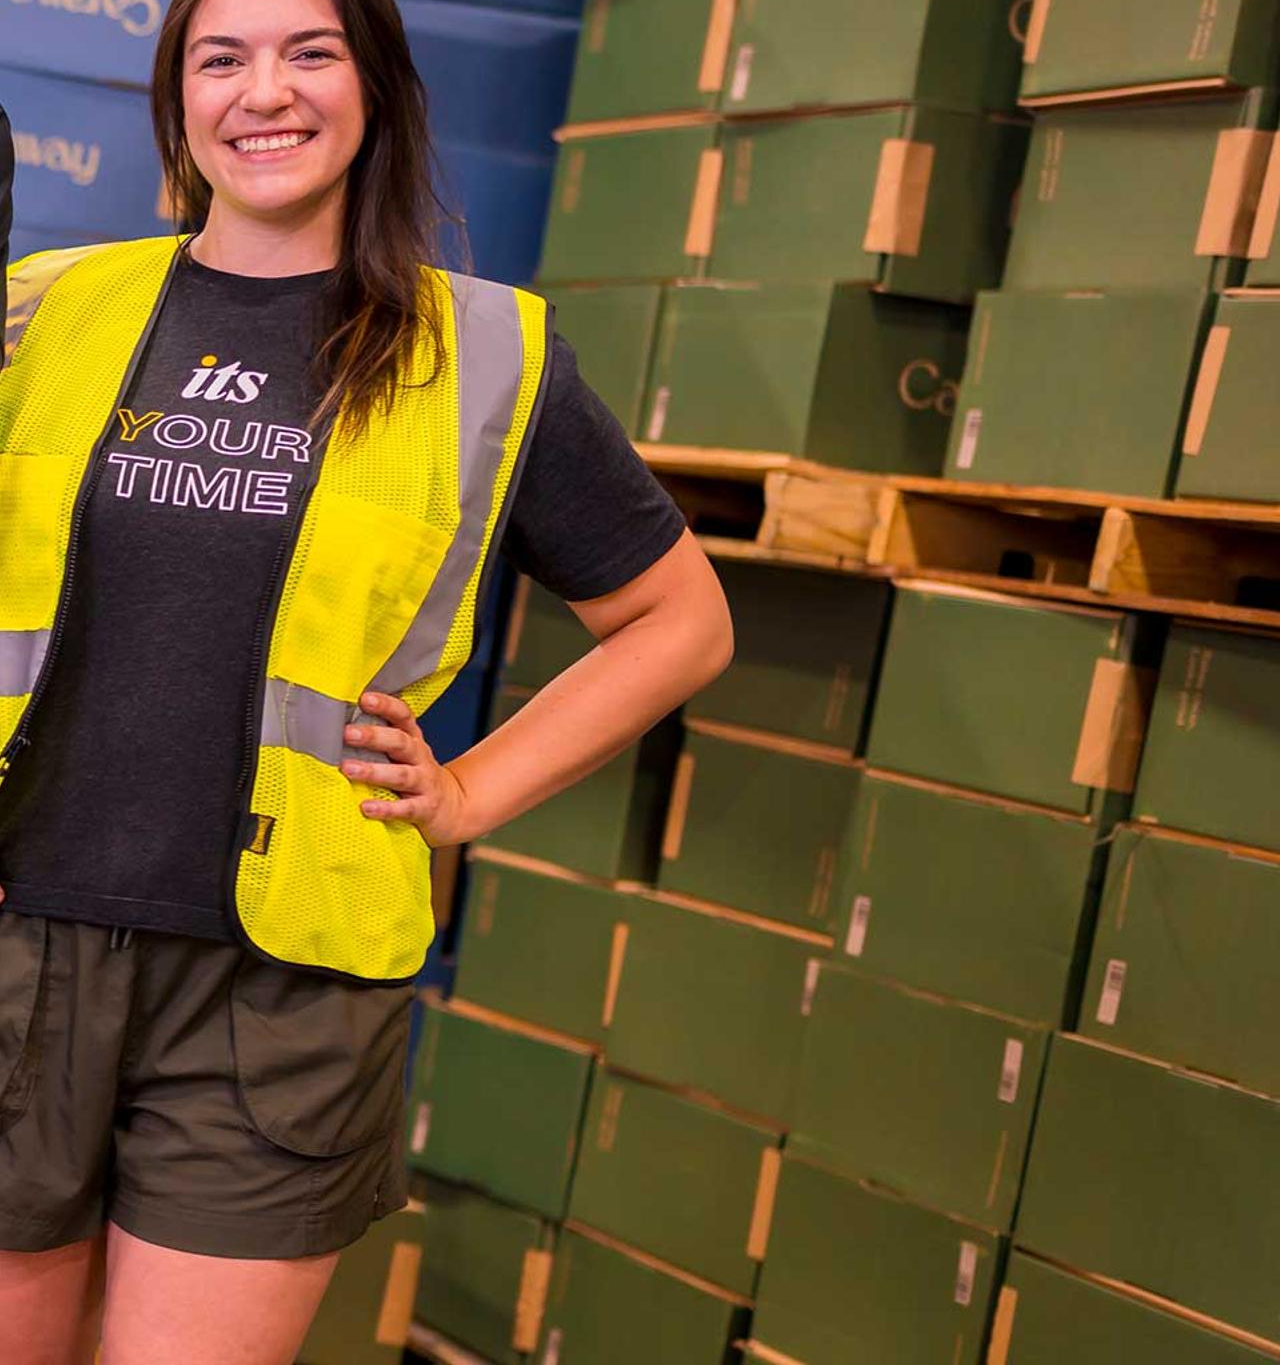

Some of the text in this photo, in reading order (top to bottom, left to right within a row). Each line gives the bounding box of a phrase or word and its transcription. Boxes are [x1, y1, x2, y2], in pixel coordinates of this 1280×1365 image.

[181, 355, 268, 403] its
[117, 409, 312, 462] YOUR
[108, 453, 292, 515] TIME
